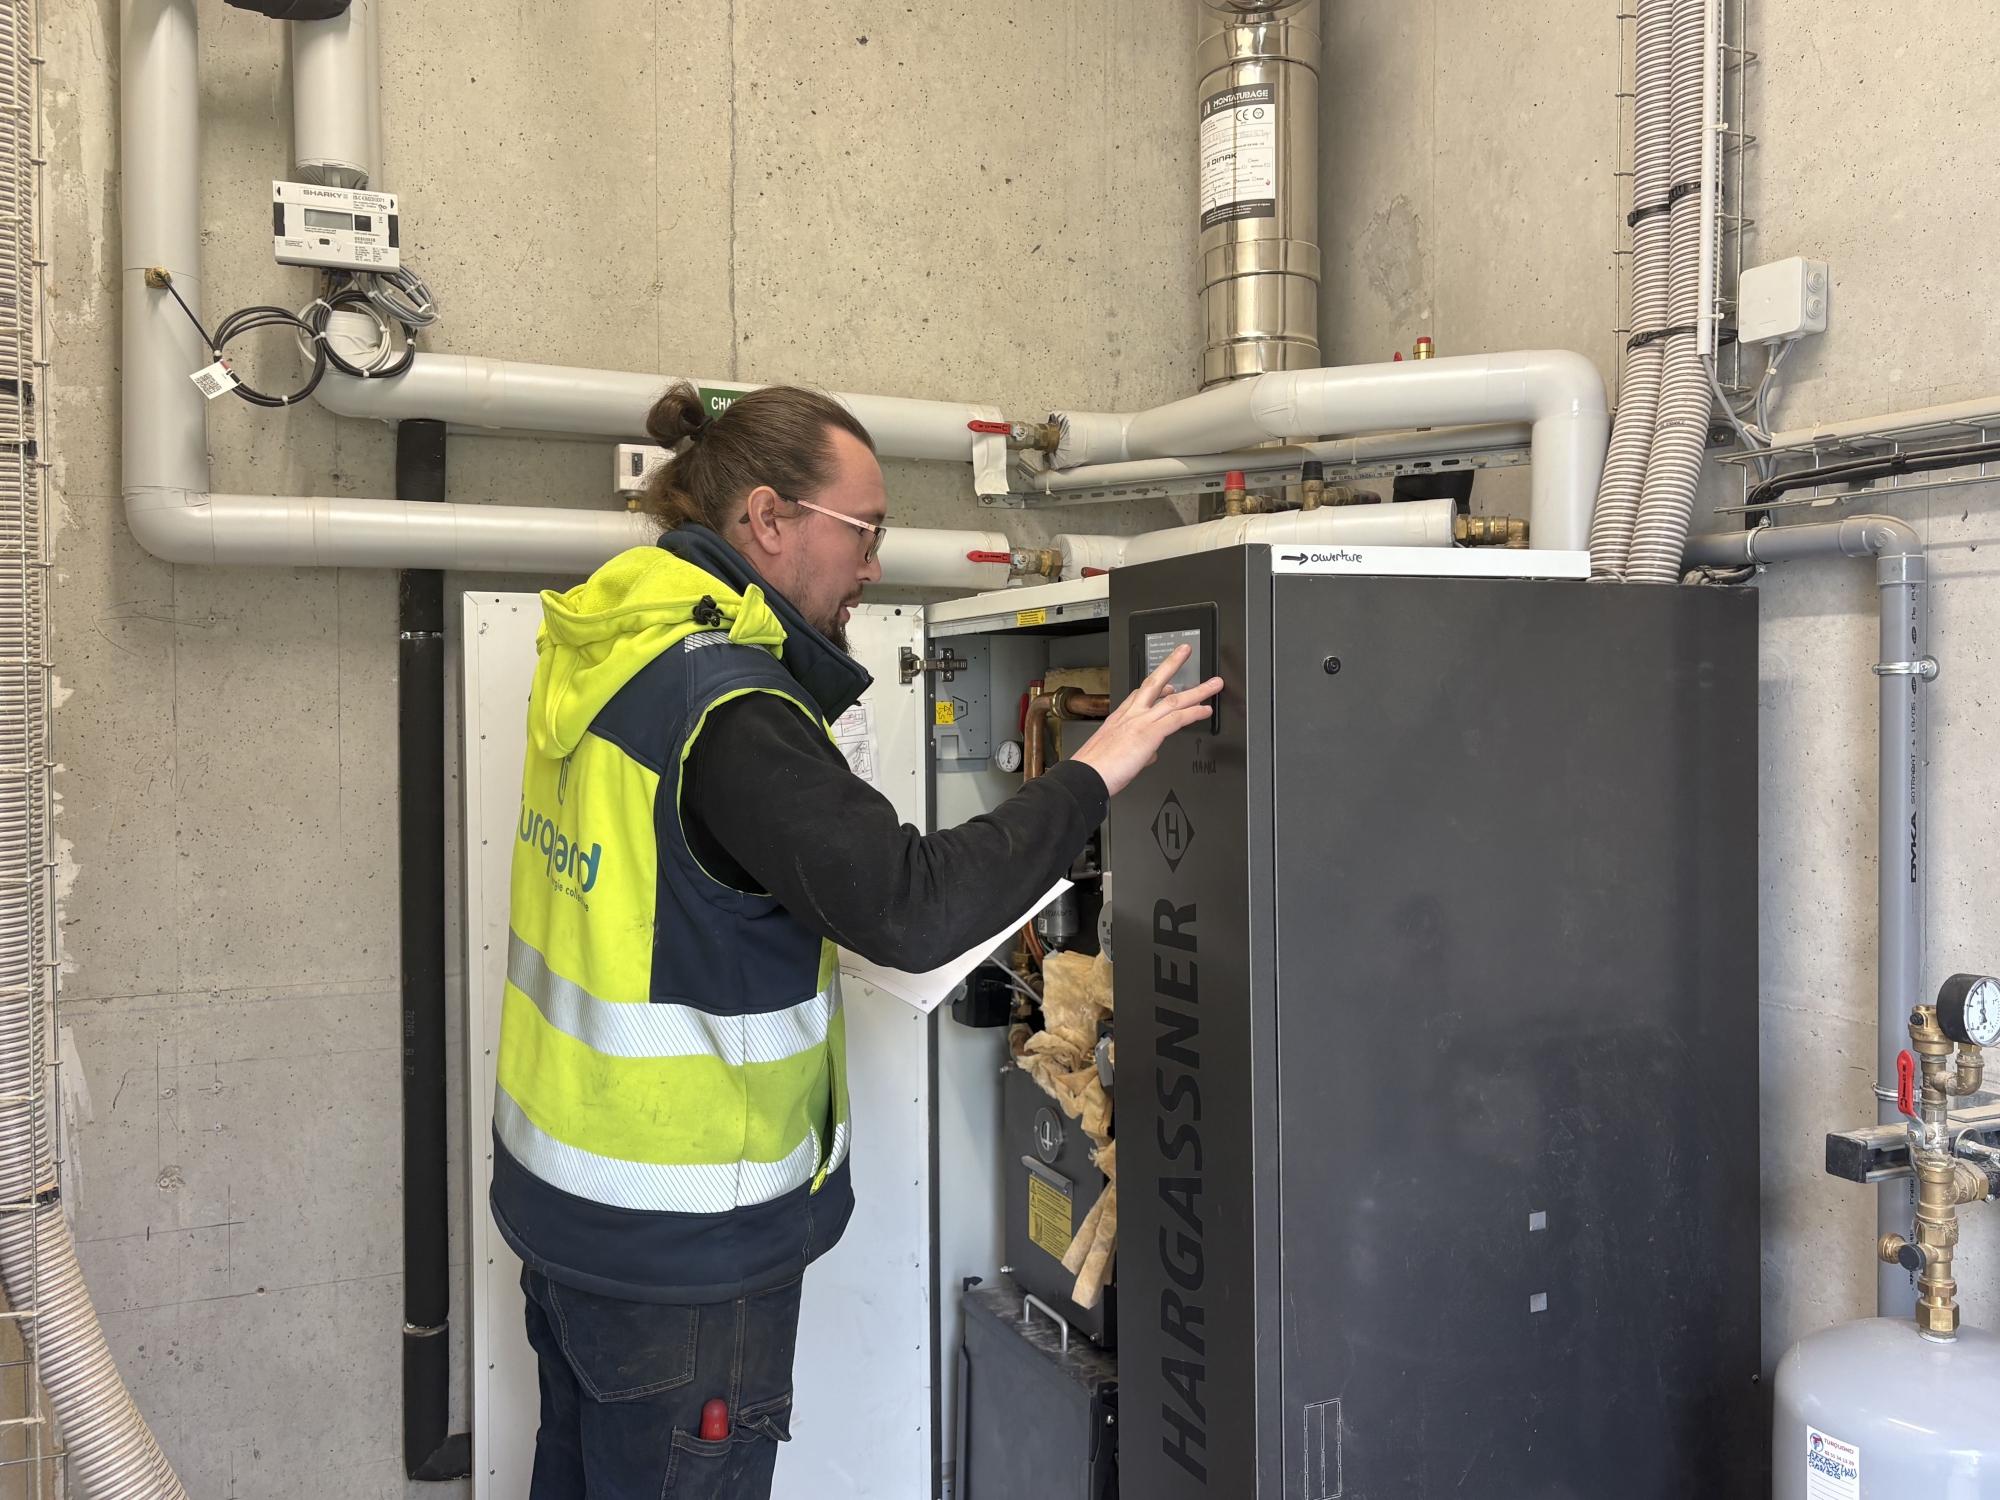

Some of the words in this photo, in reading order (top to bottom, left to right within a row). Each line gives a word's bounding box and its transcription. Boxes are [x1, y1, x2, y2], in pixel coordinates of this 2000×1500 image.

[1213, 89, 1269, 107] MONTATUBAGE
[1211, 153, 1237, 165] DINAK
[303, 189, 343, 199] SHARKY
[711, 396, 736, 411] CHA
[1310, 549, 1362, 563] ouverture
[1153, 898, 1208, 1486] HARGASSNER
[1824, 1438, 1854, 1454] TURQUAND
